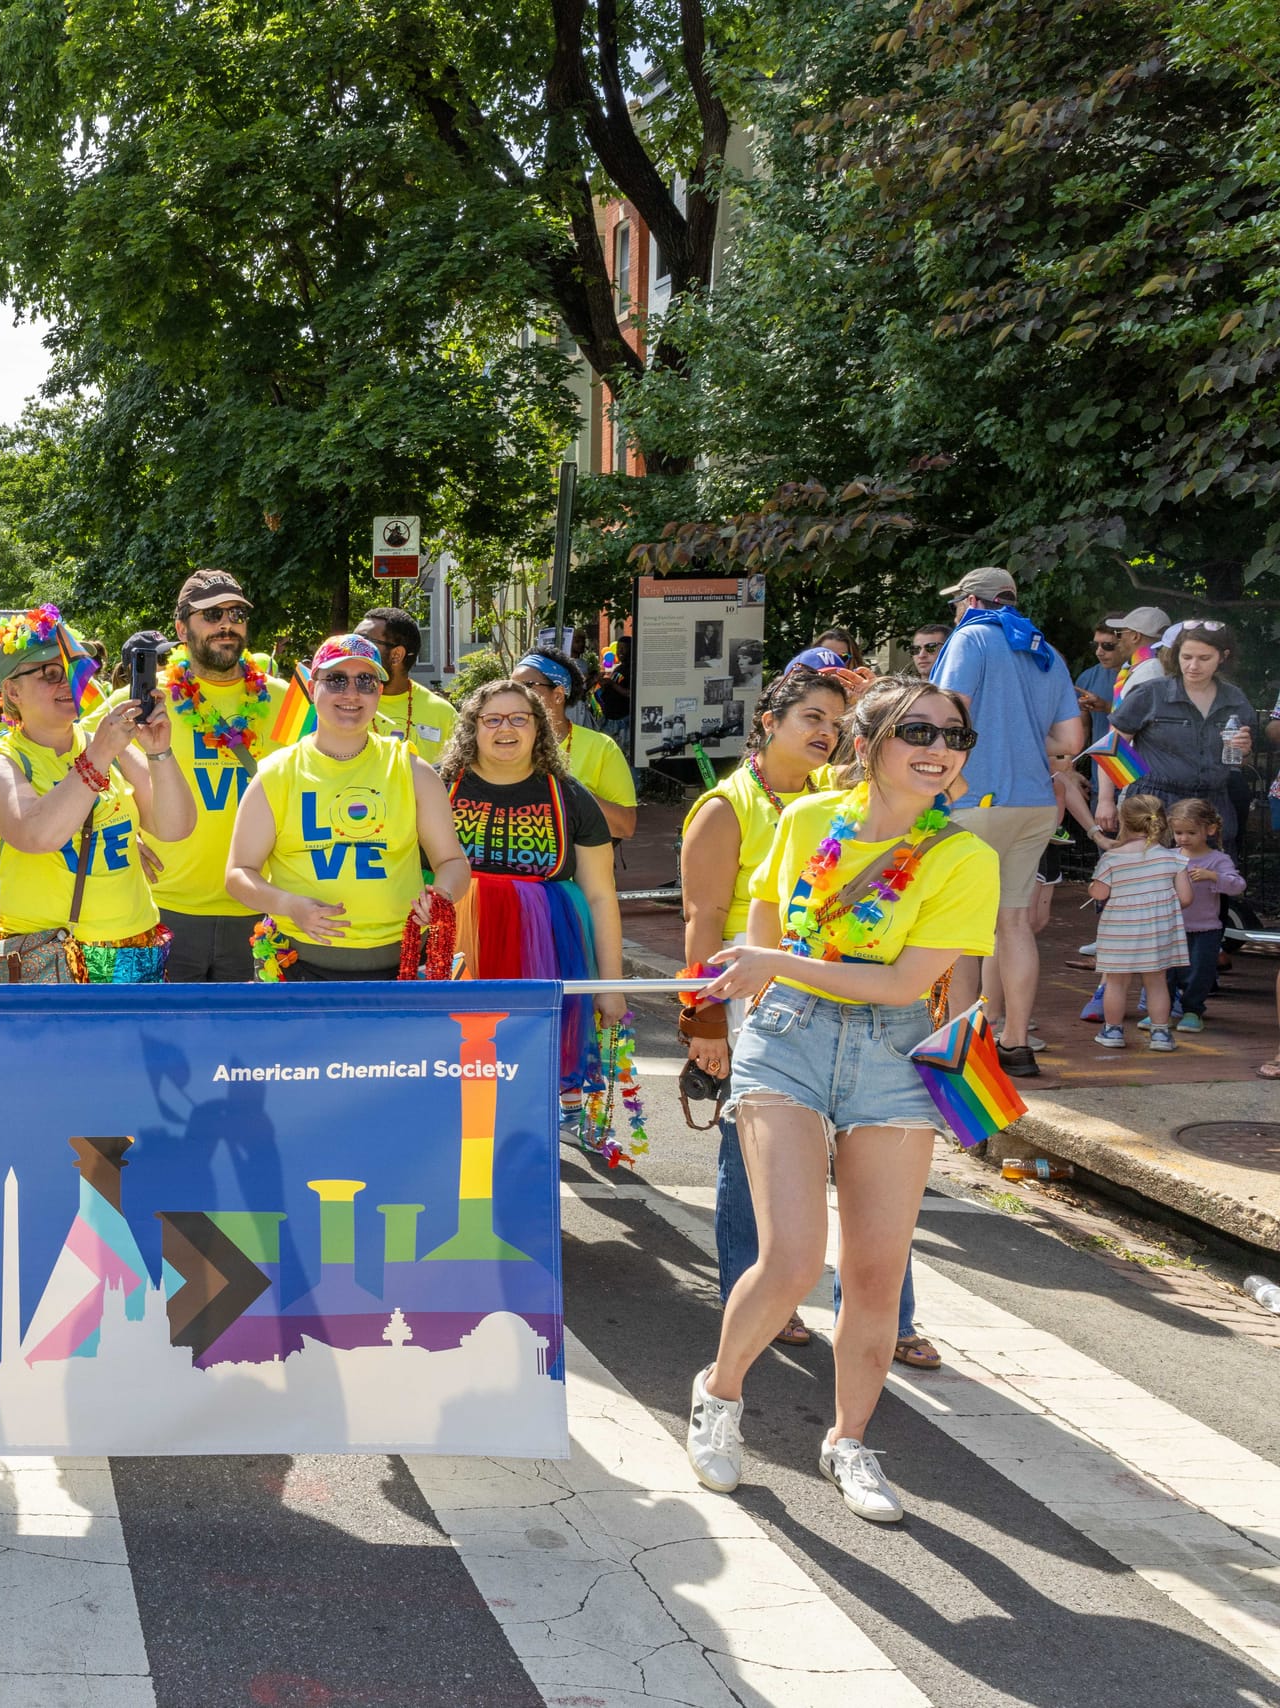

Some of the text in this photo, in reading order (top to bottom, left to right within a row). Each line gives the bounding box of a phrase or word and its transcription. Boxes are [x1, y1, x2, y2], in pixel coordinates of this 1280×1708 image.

[816, 651, 836, 665] W
[452, 808, 553, 829] OVE IS LOVE
[495, 807, 506, 817] IS
[509, 803, 552, 817] LOVE
[453, 819, 556, 840] OVE IS LOVE
[457, 831, 557, 853] VE IS LOVE
[310, 842, 388, 881] VE
[460, 843, 558, 867] VE IS LOVE
[213, 1060, 519, 1082] American Chemical Society
